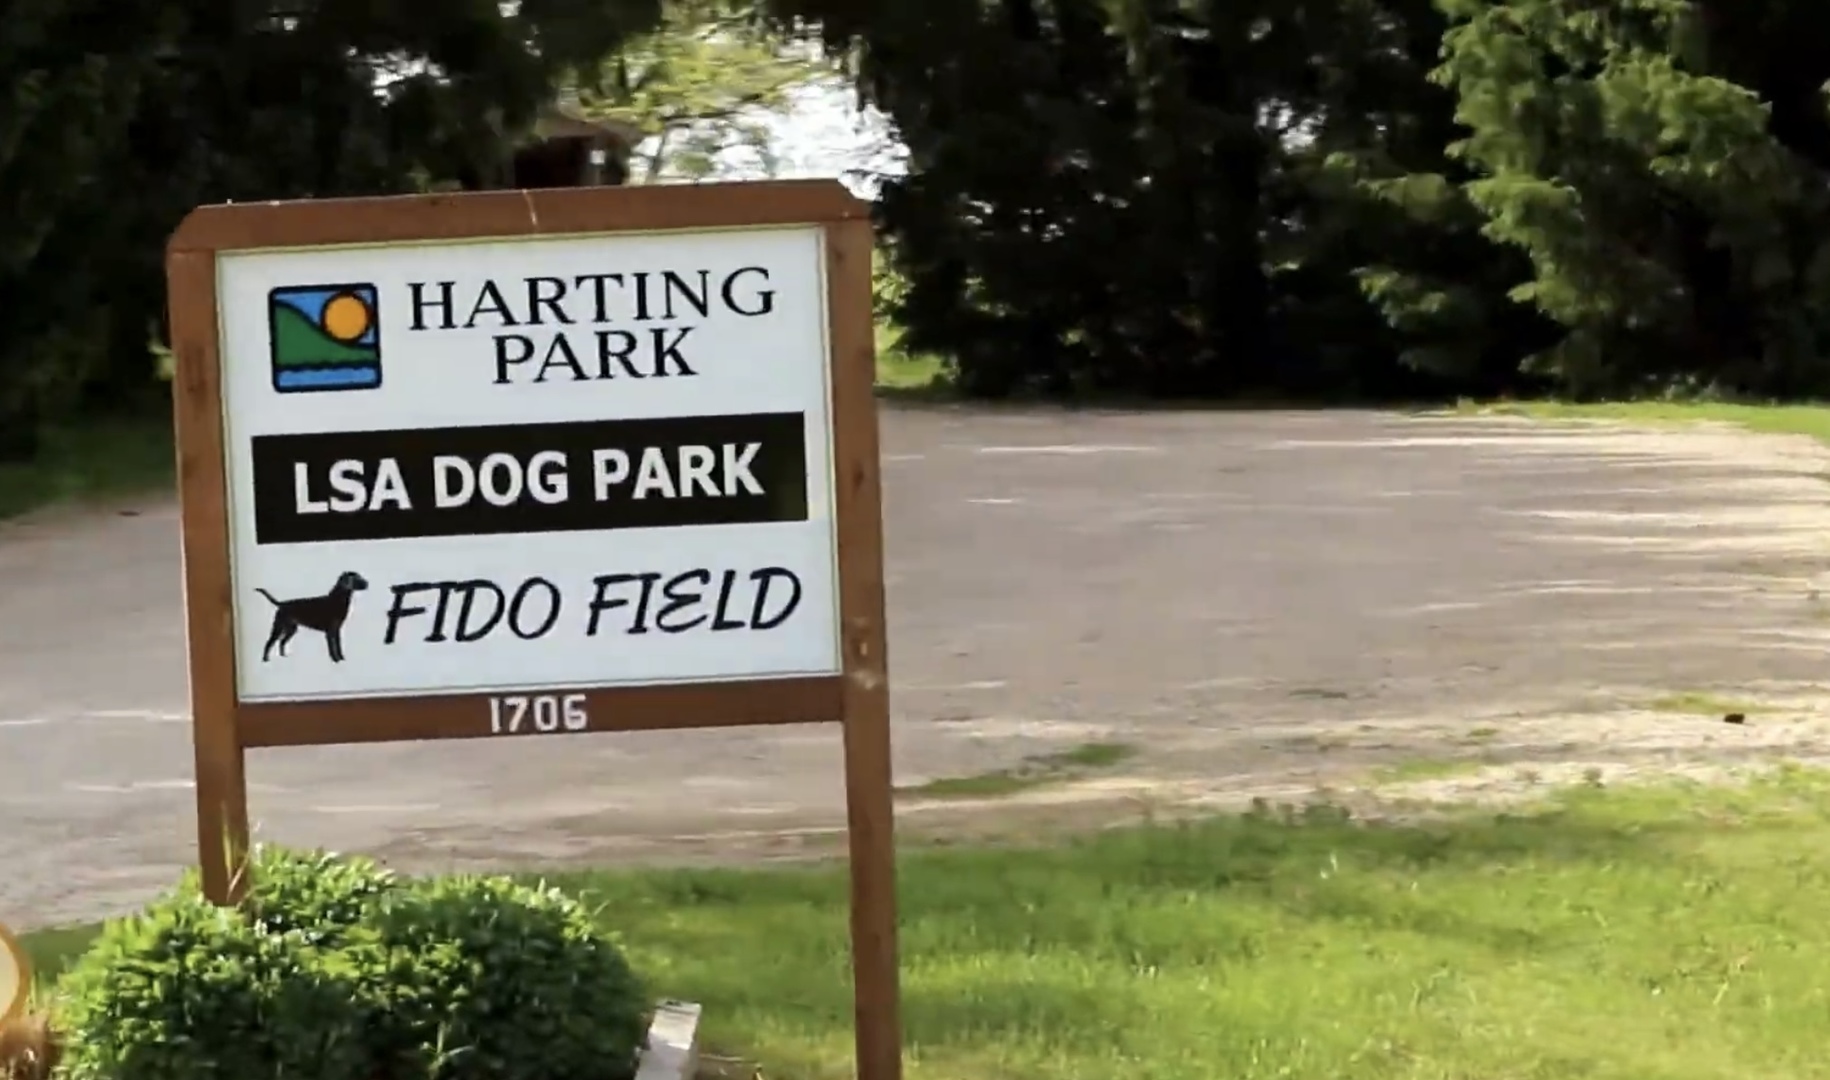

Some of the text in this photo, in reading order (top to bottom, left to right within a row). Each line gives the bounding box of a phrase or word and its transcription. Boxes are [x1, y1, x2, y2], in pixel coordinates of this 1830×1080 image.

[407, 266, 776, 331] HARTING
[491, 327, 698, 385] PARK
[294, 442, 764, 514] LSA DOG PARK
[383, 566, 803, 645] FIDO FIELD
[489, 693, 588, 733] 1706
